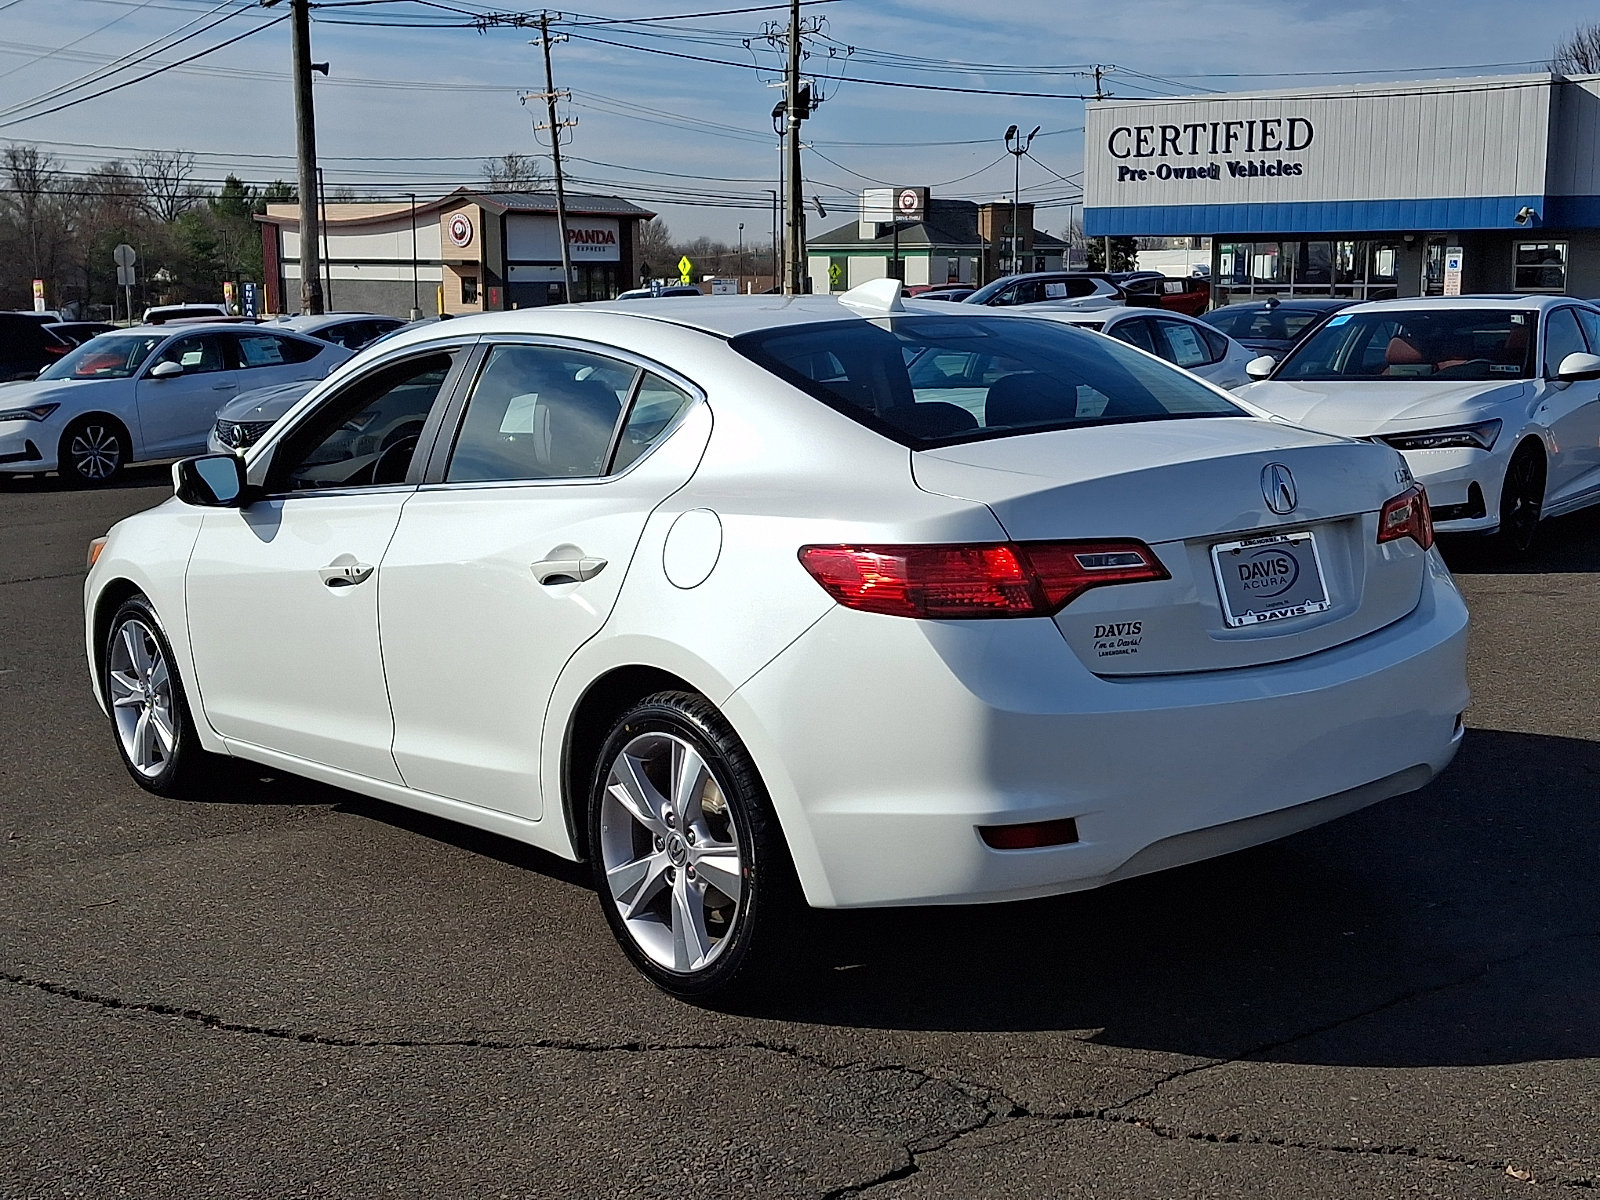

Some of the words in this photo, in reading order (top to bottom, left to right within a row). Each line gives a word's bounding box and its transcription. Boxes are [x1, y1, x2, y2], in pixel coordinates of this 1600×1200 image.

[1107, 117, 1314, 158] CERTIFIED
[1117, 162, 1220, 182] Pre-Owned
[1226, 159, 1303, 178] Vehicles
[567, 229, 616, 244] PANDA
[1238, 558, 1289, 581] DAVIS
[1243, 576, 1288, 591] ACURA
[1256, 607, 1306, 622] DAVIS
[1093, 621, 1142, 638] DAVIS
[1117, 637, 1142, 647] Davis!
